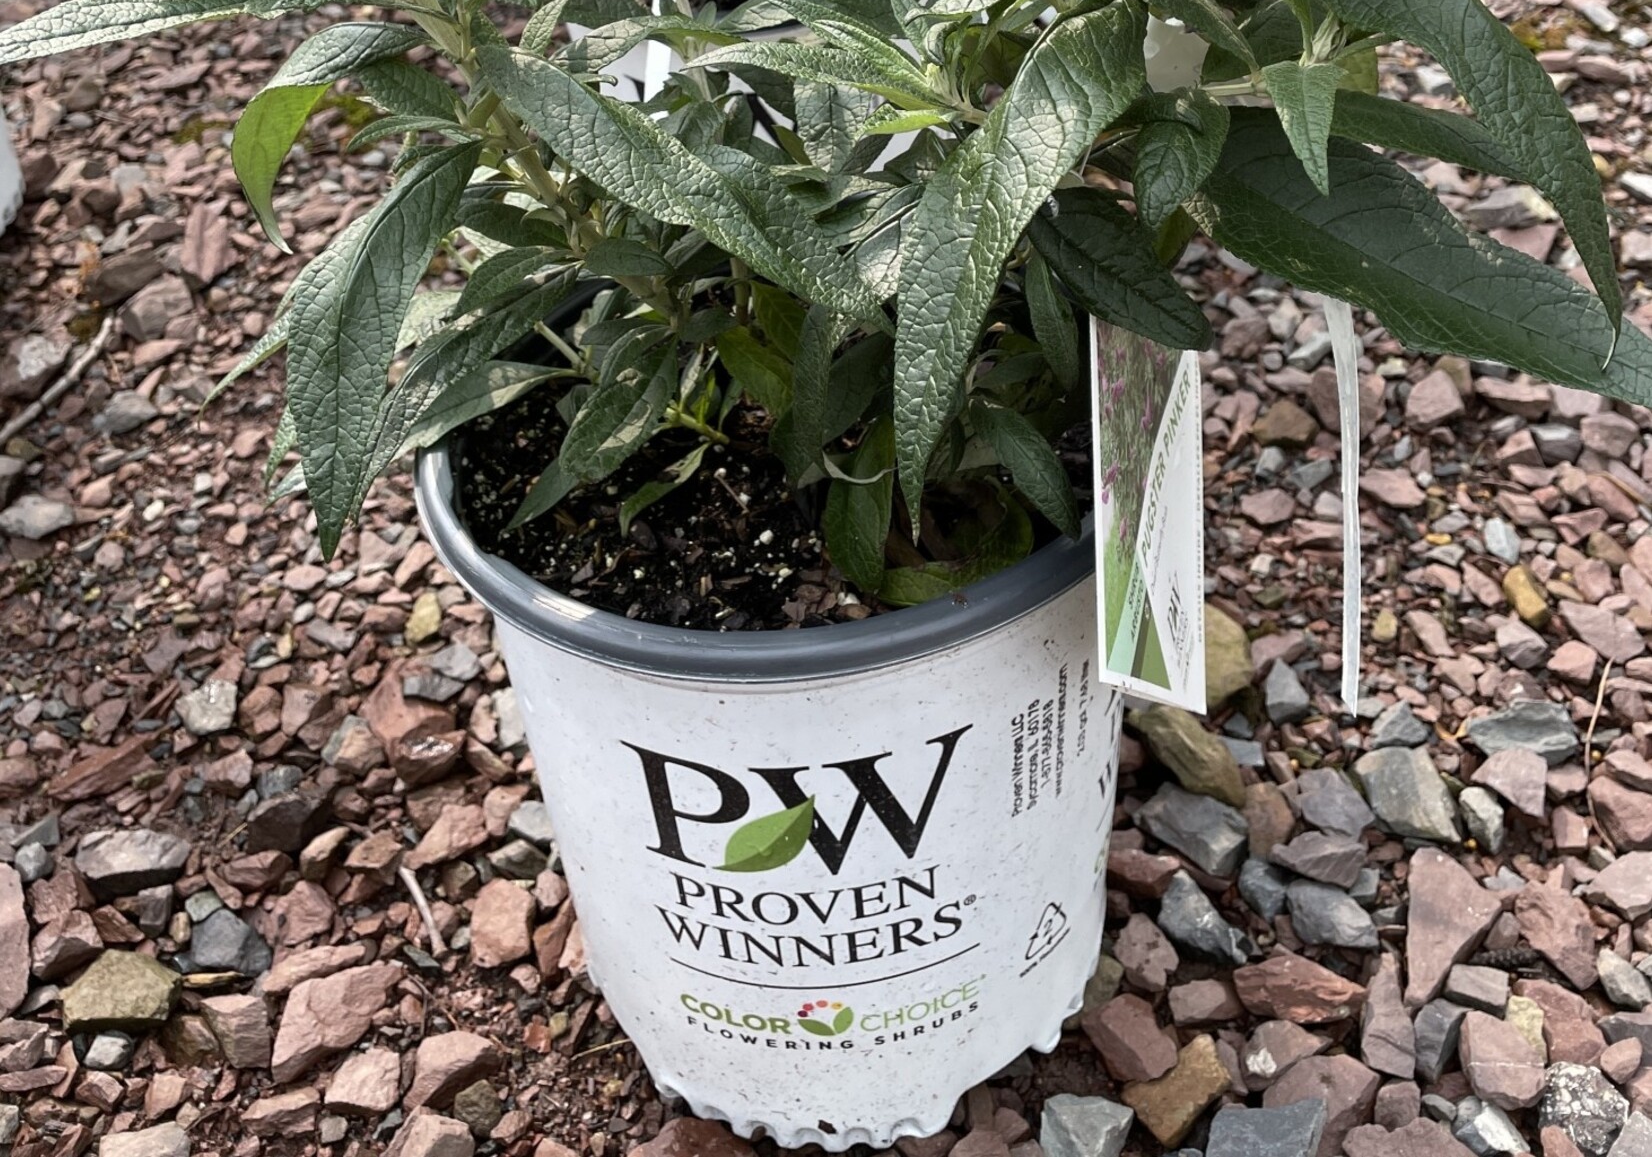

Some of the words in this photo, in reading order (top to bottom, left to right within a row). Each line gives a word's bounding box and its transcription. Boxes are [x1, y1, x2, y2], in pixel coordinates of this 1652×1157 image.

[1141, 451, 1166, 568] PUGSTER
[620, 723, 974, 875] PW
[669, 864, 941, 925] PROVEN
[680, 993, 792, 1035] COLOR
[686, 1016, 855, 1050] FLOWERING
[875, 1002, 980, 1047] SHRUBS
